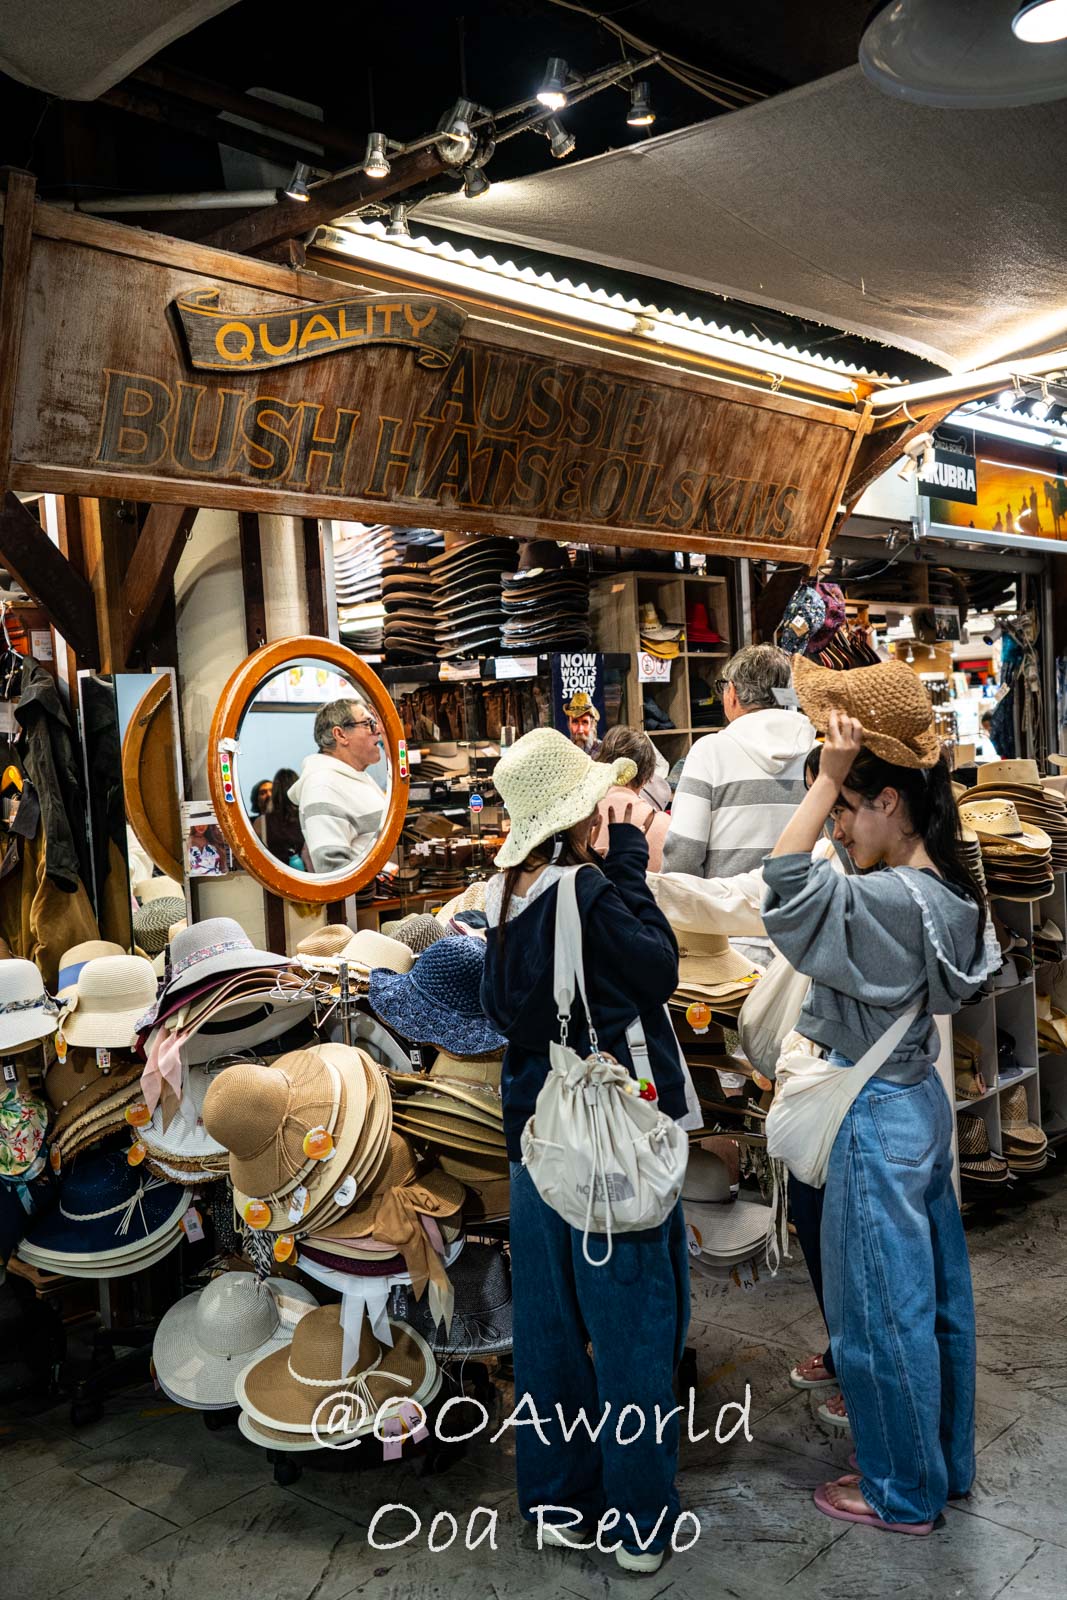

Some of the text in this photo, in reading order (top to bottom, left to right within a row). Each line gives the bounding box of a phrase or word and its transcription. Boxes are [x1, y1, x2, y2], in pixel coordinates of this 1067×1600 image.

[214, 303, 438, 361] QUALITY
[420, 346, 662, 457] AUSSIE
[95, 367, 362, 493] BUSH
[364, 414, 560, 515] HATS
[560, 653, 597, 667] NOW
[560, 667, 597, 677] WHAT'S
[561, 676, 597, 688] YOUR
